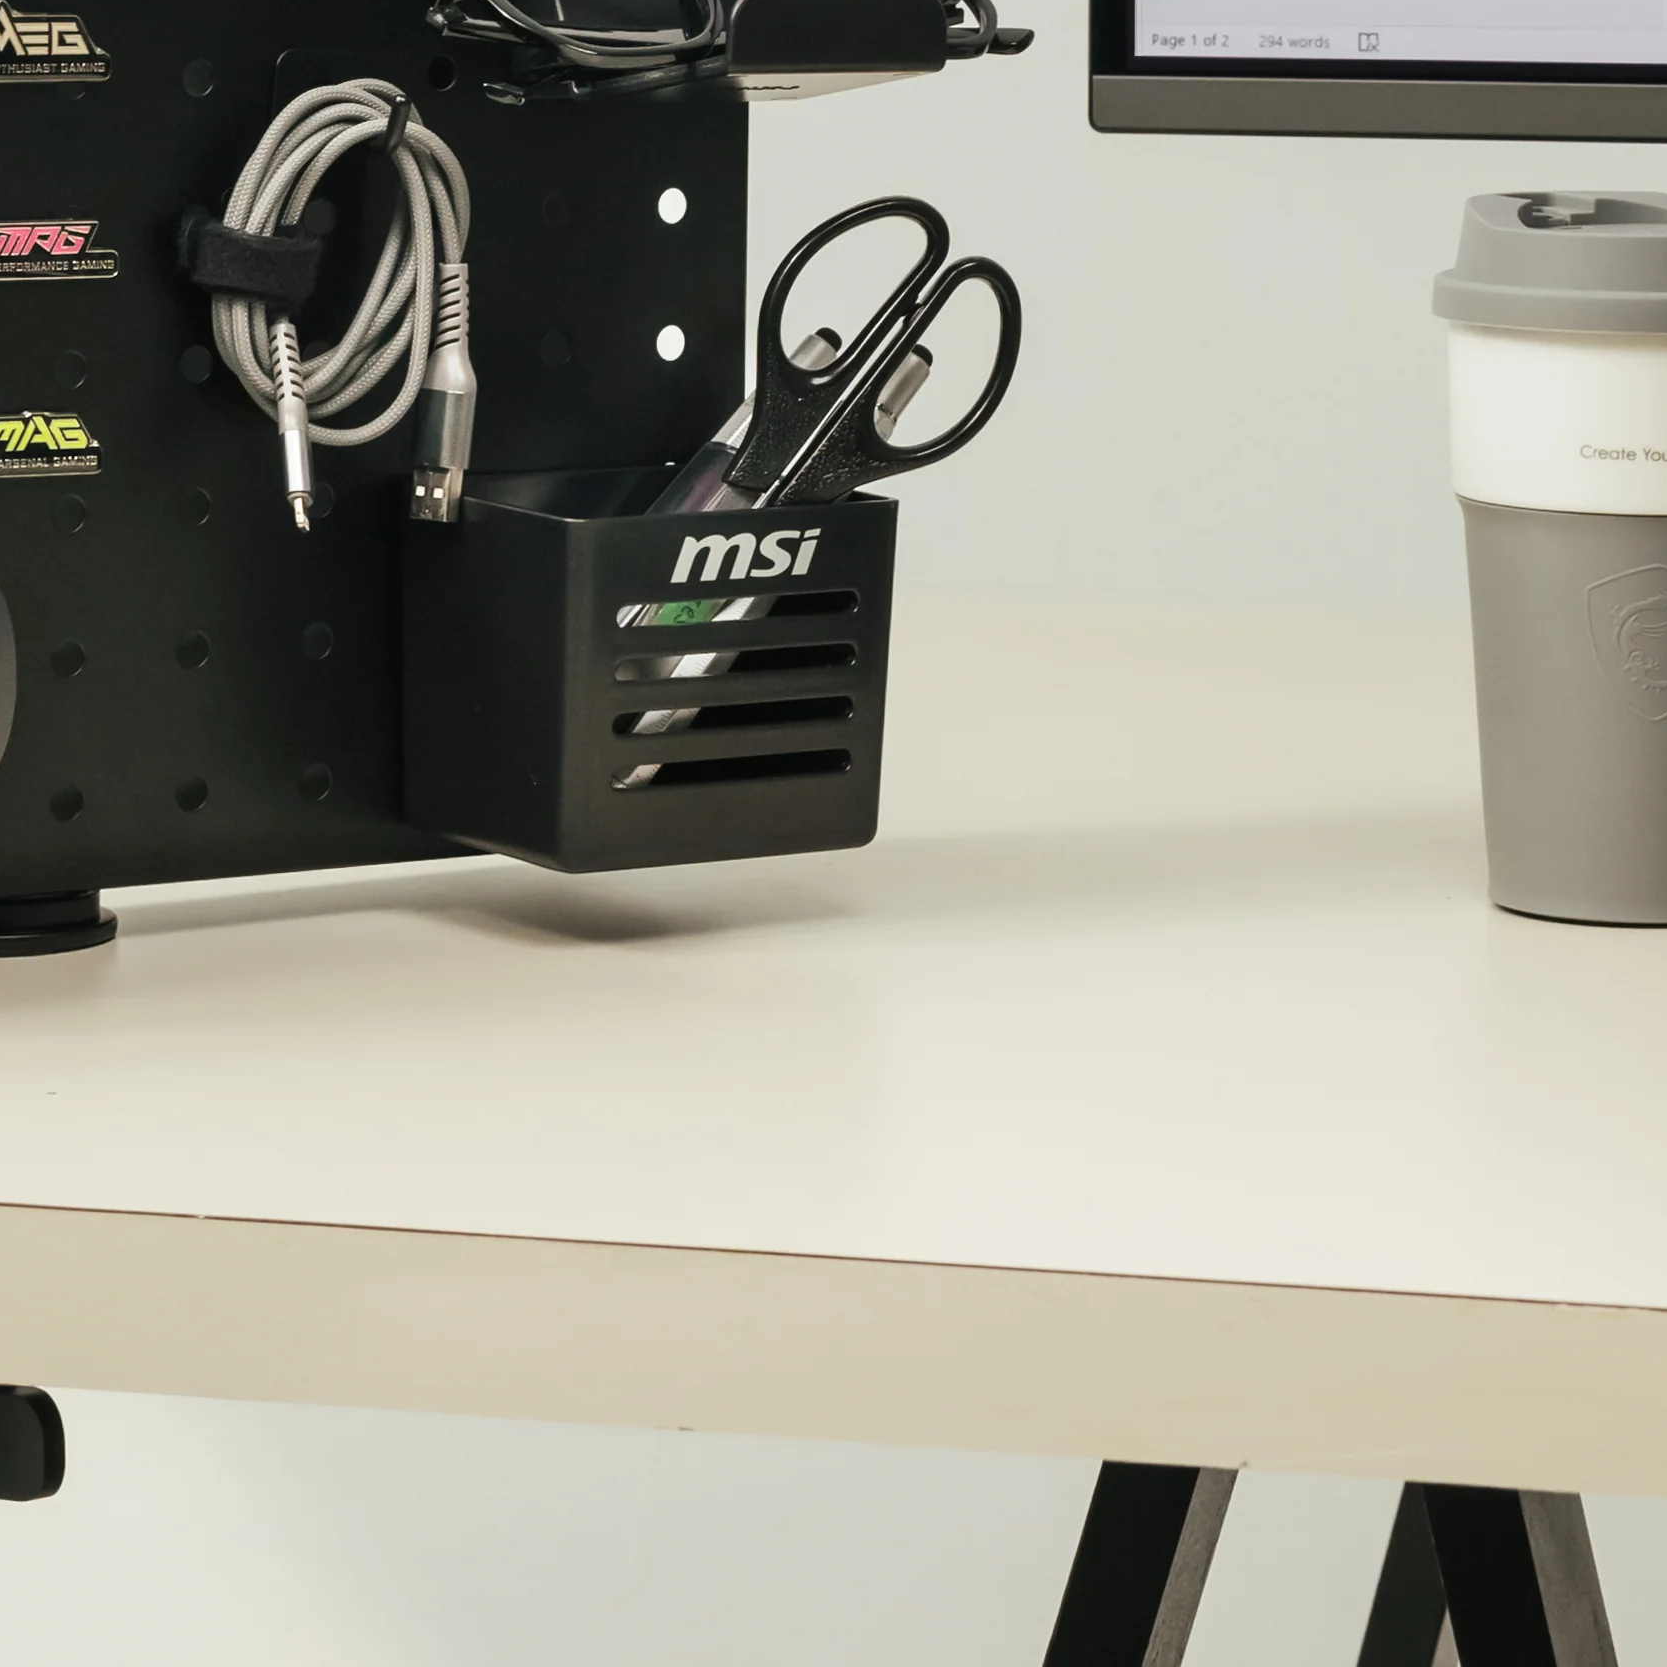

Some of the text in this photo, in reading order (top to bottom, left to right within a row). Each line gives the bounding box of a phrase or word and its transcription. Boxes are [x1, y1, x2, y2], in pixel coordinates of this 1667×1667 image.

[1152, 33, 1230, 49] Page 1 of 2
[1580, 445, 1636, 462] Create
[670, 528, 822, 584] msi
